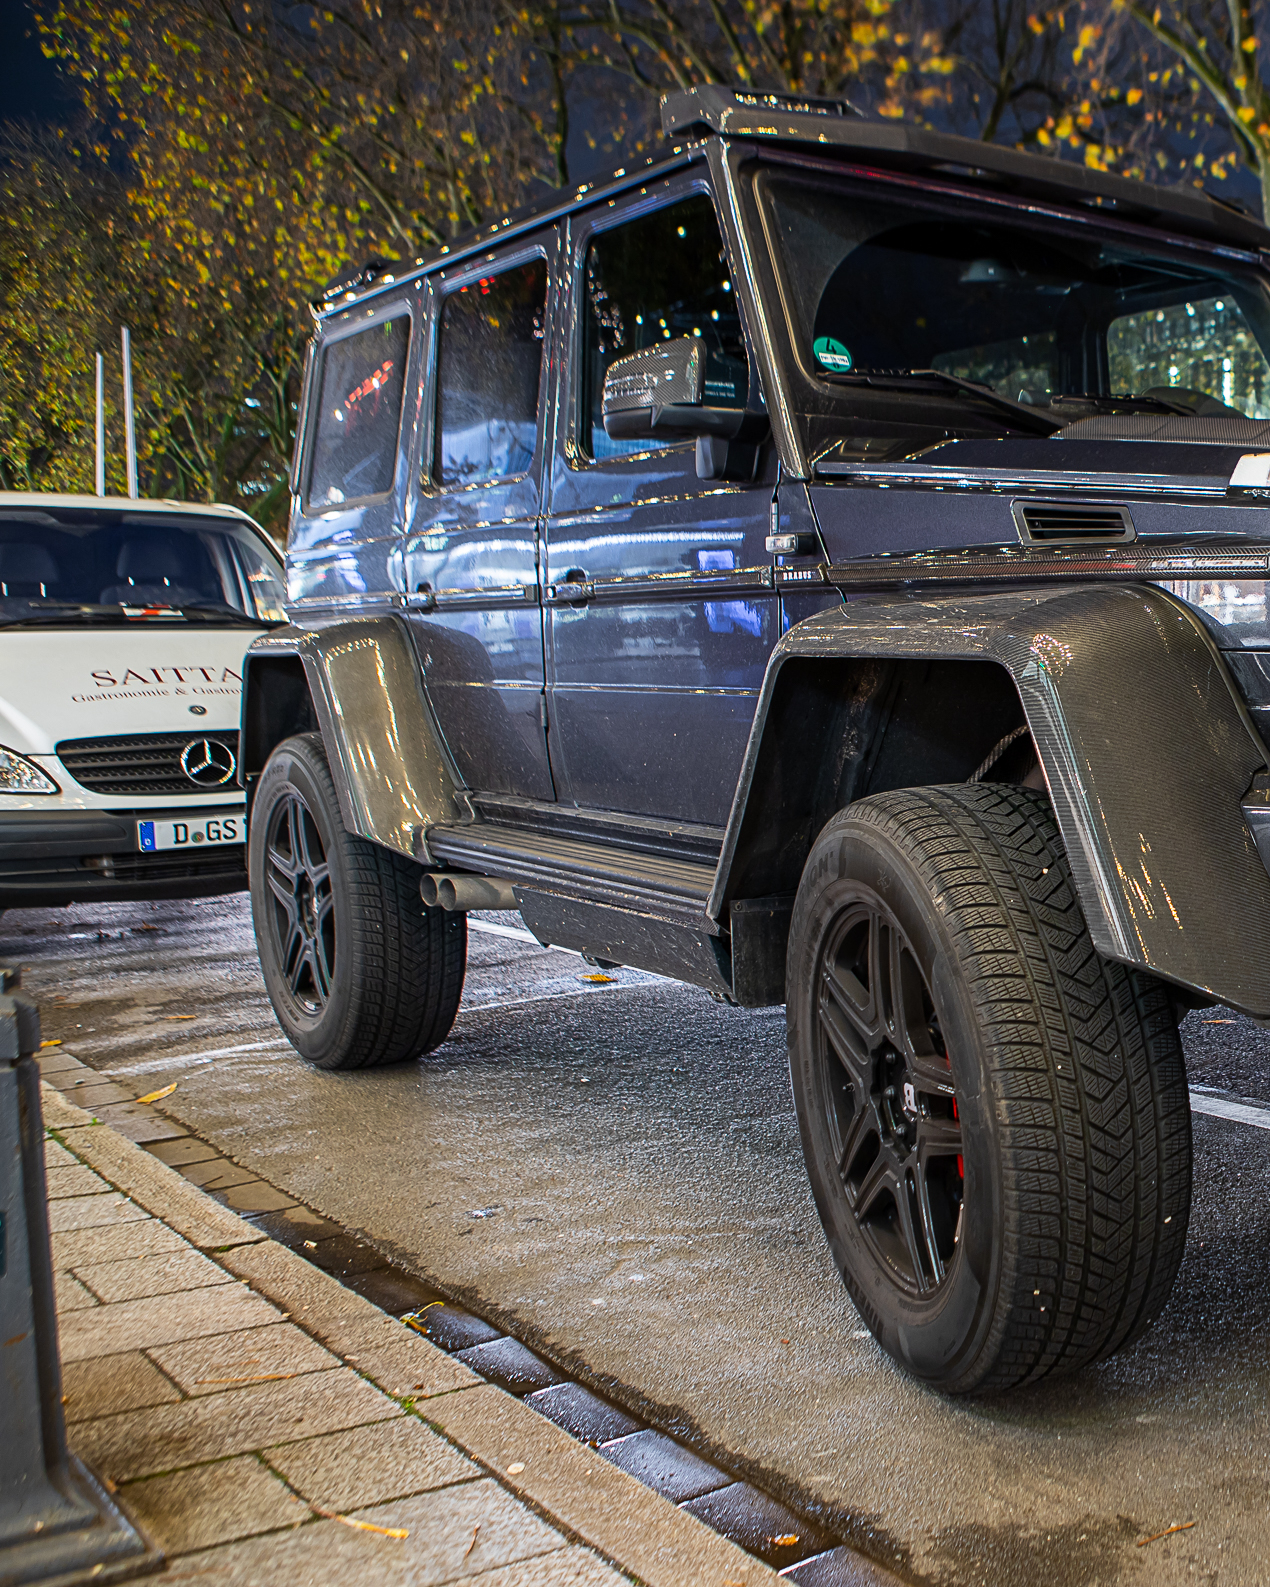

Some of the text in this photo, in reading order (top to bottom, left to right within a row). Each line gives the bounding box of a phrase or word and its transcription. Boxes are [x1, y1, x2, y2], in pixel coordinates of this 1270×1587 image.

[783, 571, 812, 580] BRABUS
[90, 666, 243, 688] SAITTA
[71, 686, 243, 703] Gastronomie & Gastro
[172, 823, 189, 844] D
[206, 819, 247, 842] GS
